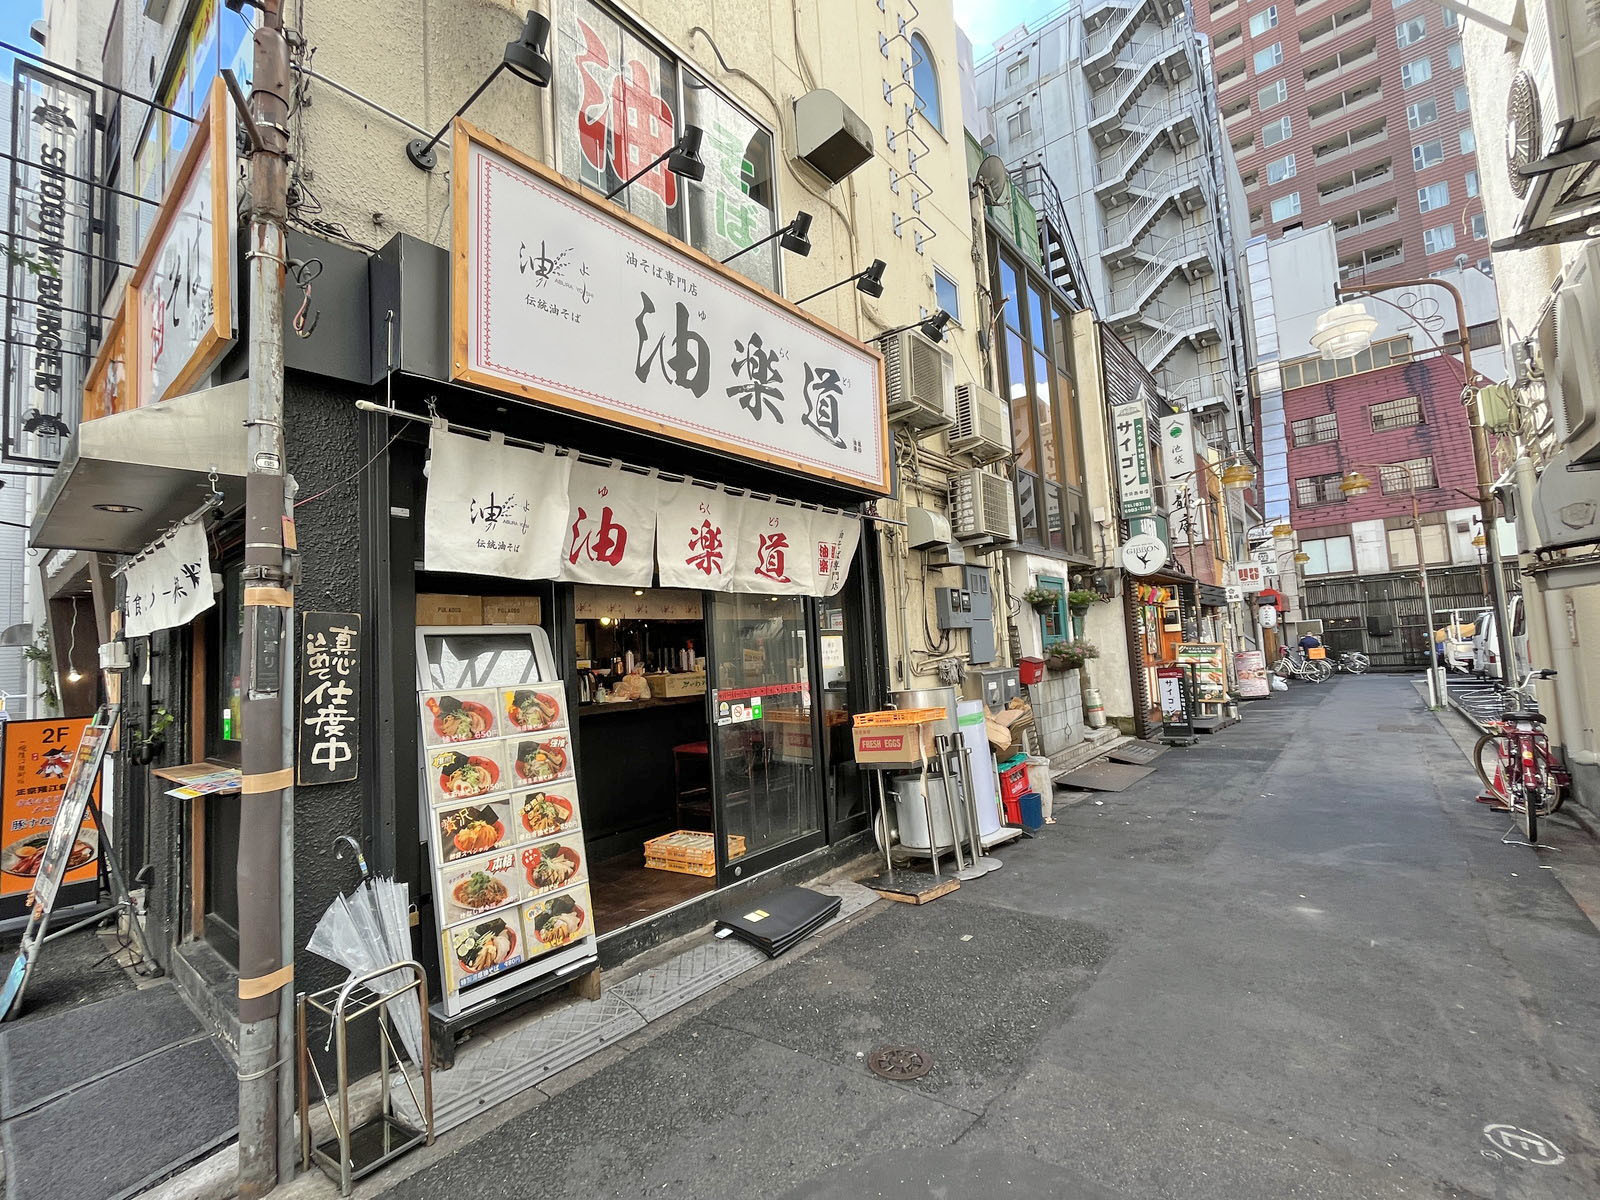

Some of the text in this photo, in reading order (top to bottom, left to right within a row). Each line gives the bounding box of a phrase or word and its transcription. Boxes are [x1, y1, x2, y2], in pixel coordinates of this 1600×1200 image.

[626, 251, 698, 297] 油そば専門店
[525, 294, 582, 324] 伝統油そば
[35, 272, 64, 393] BURGER
[634, 291, 847, 449] 油楽道
[1117, 421, 1137, 487] サイゴン
[1171, 444, 1185, 464] 池袋
[597, 486, 609, 497] ゆ
[476, 538, 520, 553] 伝統油そば
[569, 506, 791, 584] 油楽道
[1126, 545, 1160, 555] GIBBON
[329, 625, 358, 675] 真心
[42, 727, 70, 743] 2F
[304, 679, 356, 772] 仕度中
[862, 739, 901, 748] FRESH EGGS
[492, 854, 513, 871] 本格
